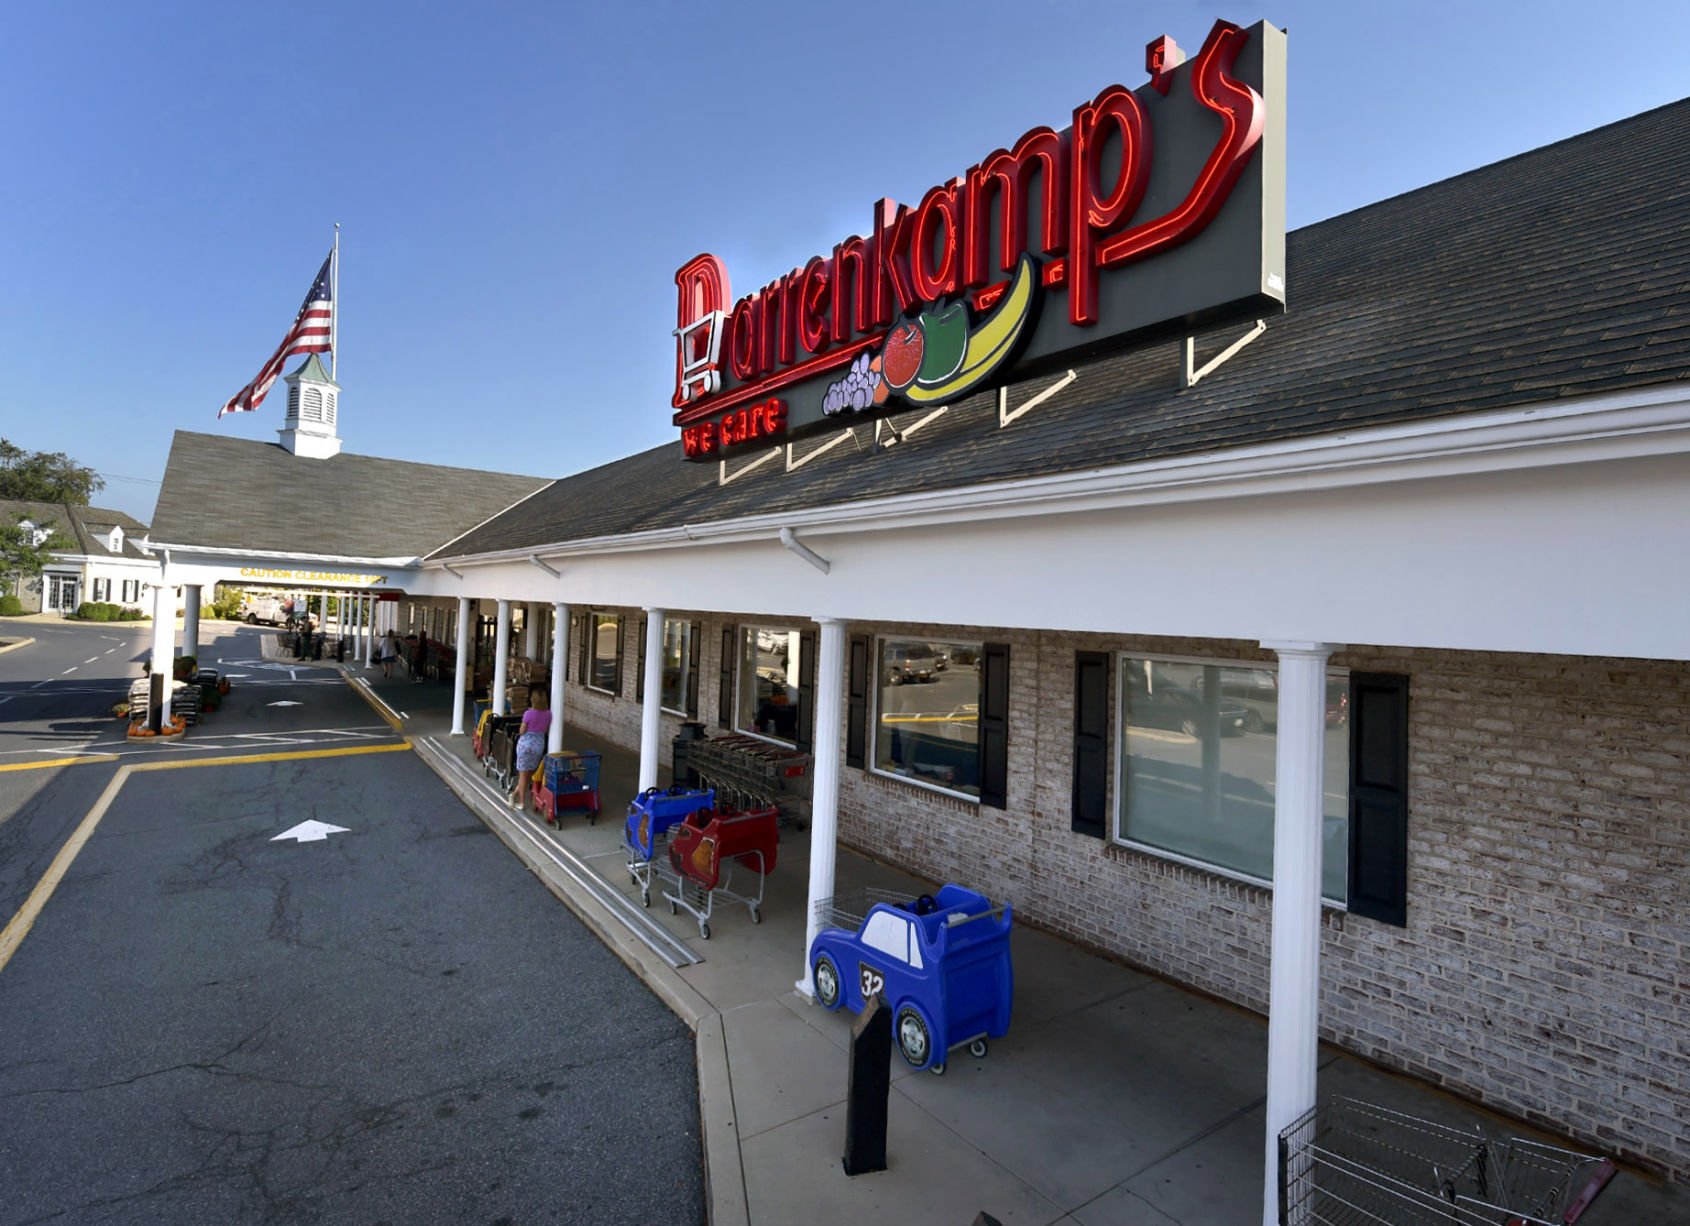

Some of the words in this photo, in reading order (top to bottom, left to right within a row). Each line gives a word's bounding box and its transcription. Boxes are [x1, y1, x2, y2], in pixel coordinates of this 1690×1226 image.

[672, 19, 1265, 408] Darrenkamp's
[720, 397, 788, 446] care
[240, 567, 292, 579] CAUTION
[295, 570, 361, 583] CLEARANCE
[861, 970, 883, 997] 32
